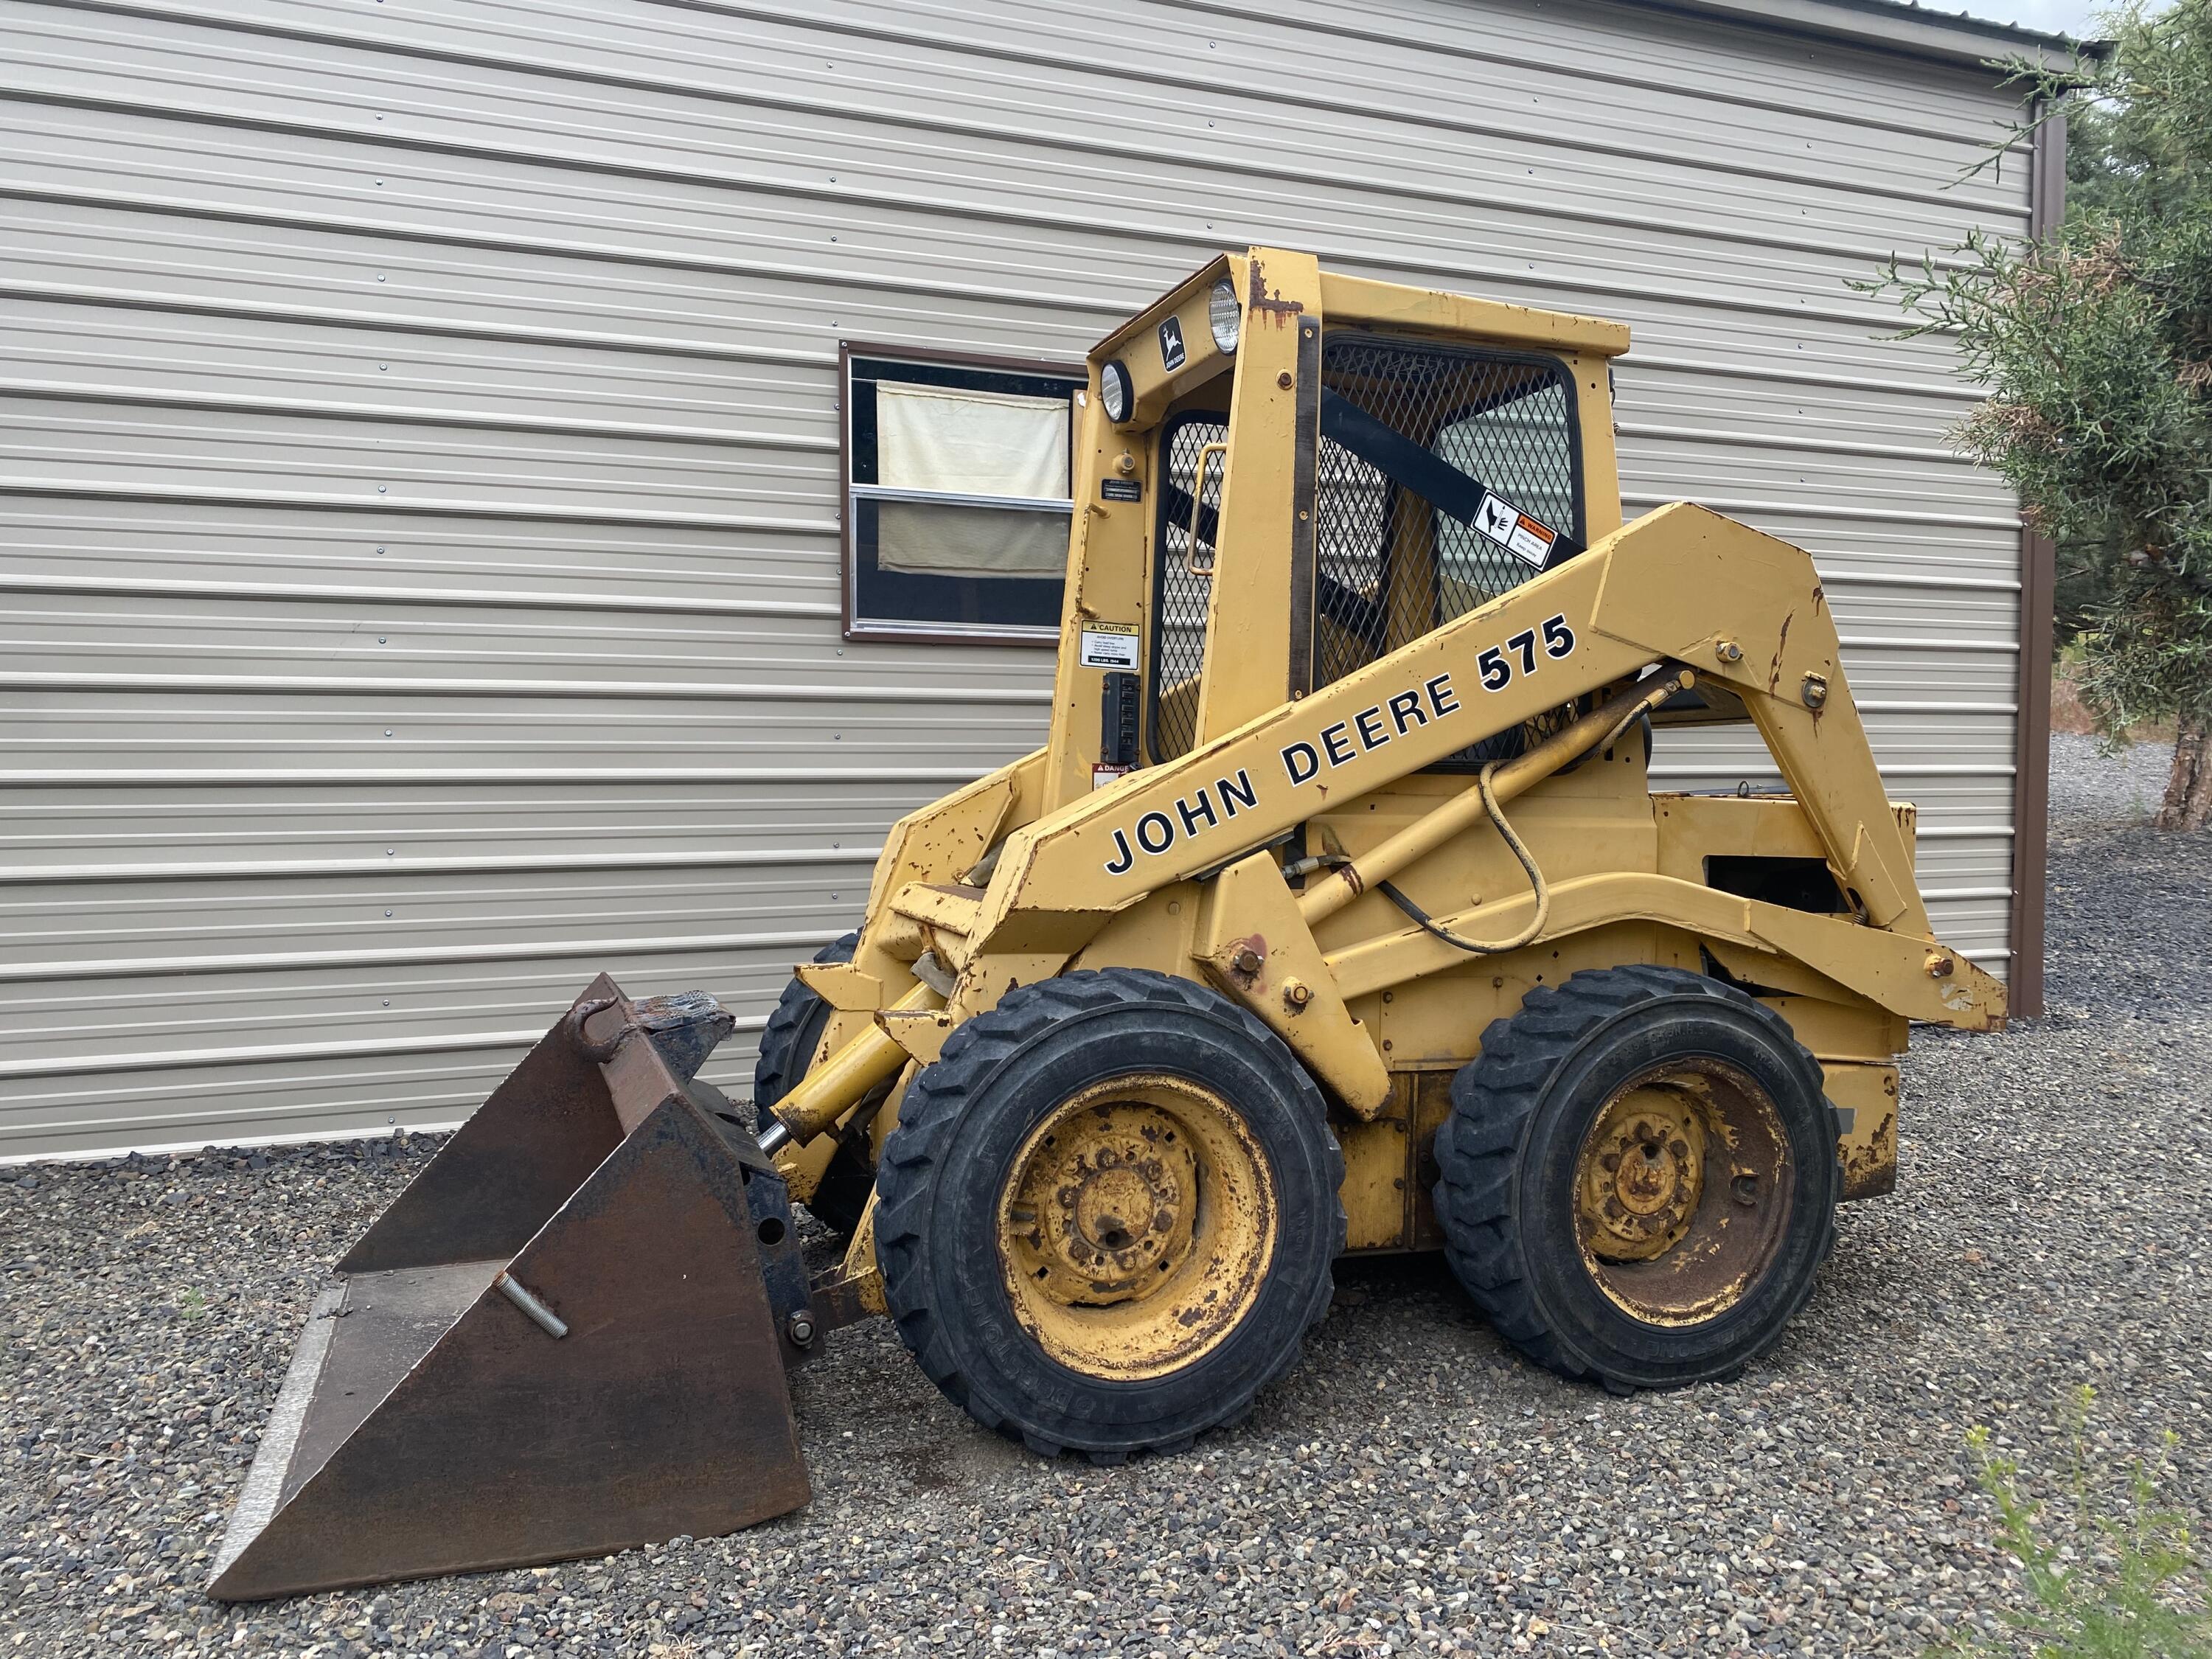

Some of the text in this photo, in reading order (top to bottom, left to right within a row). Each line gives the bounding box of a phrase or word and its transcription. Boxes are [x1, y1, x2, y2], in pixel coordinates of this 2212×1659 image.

[1166, 352, 1185, 369] JOHN DEERE
[1528, 523, 1551, 540] WARNING
[1517, 533, 1543, 551] PINCH AREA
[1099, 625, 1131, 633] CAUTION
[1105, 613, 1575, 875] JOHN DEERE 575
